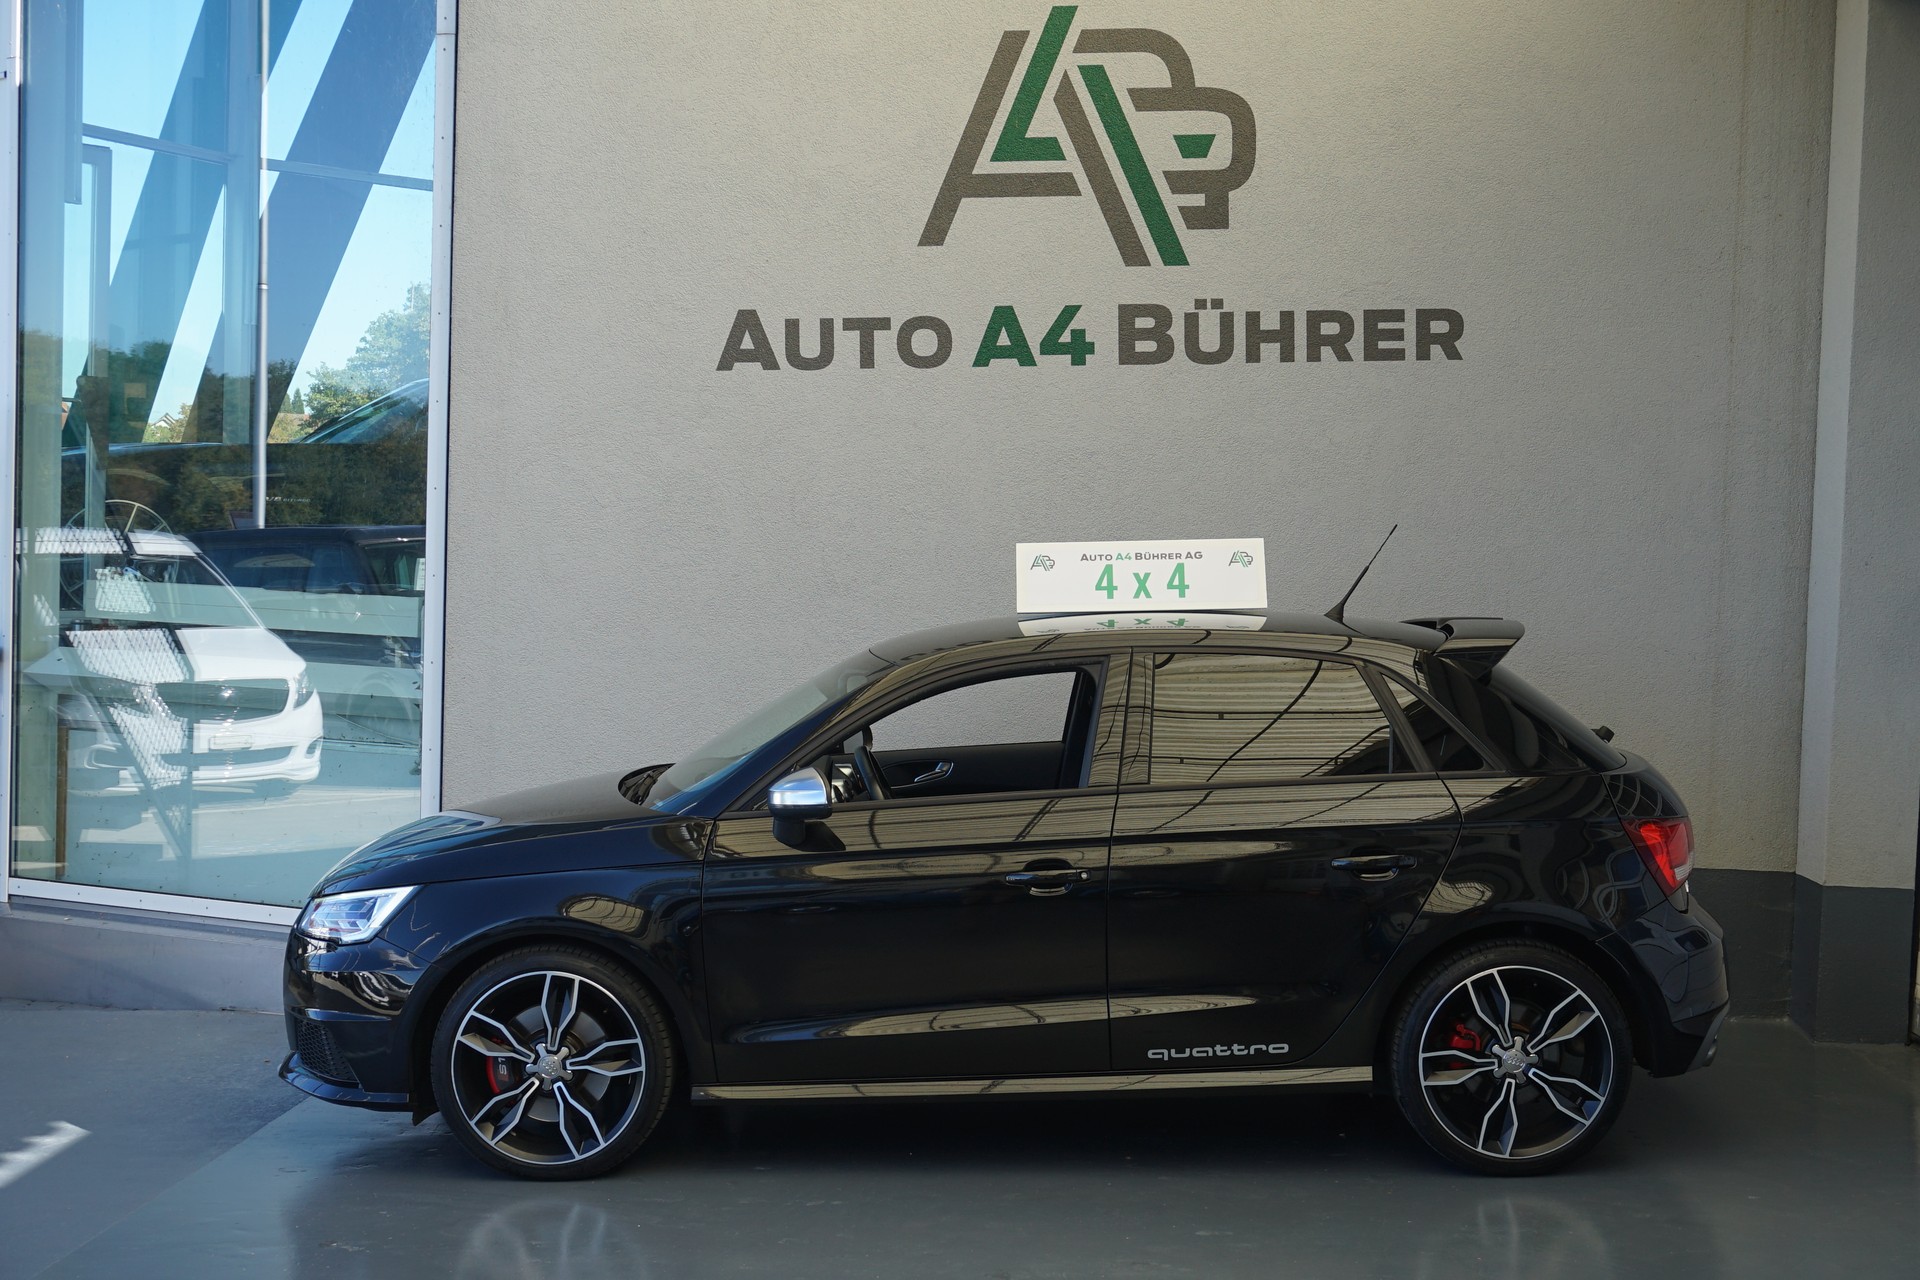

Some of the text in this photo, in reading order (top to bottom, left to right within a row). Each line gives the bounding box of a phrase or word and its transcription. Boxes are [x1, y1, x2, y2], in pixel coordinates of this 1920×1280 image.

[715, 298, 1465, 371] AUTO A4 BÜHRER
[1080, 551, 1203, 562] AUTO A4 BÜHRER AG
[1095, 563, 1118, 599] 4
[1166, 562, 1190, 598] 4
[1147, 1043, 1289, 1061] quattro
[497, 1057, 507, 1075] S1
